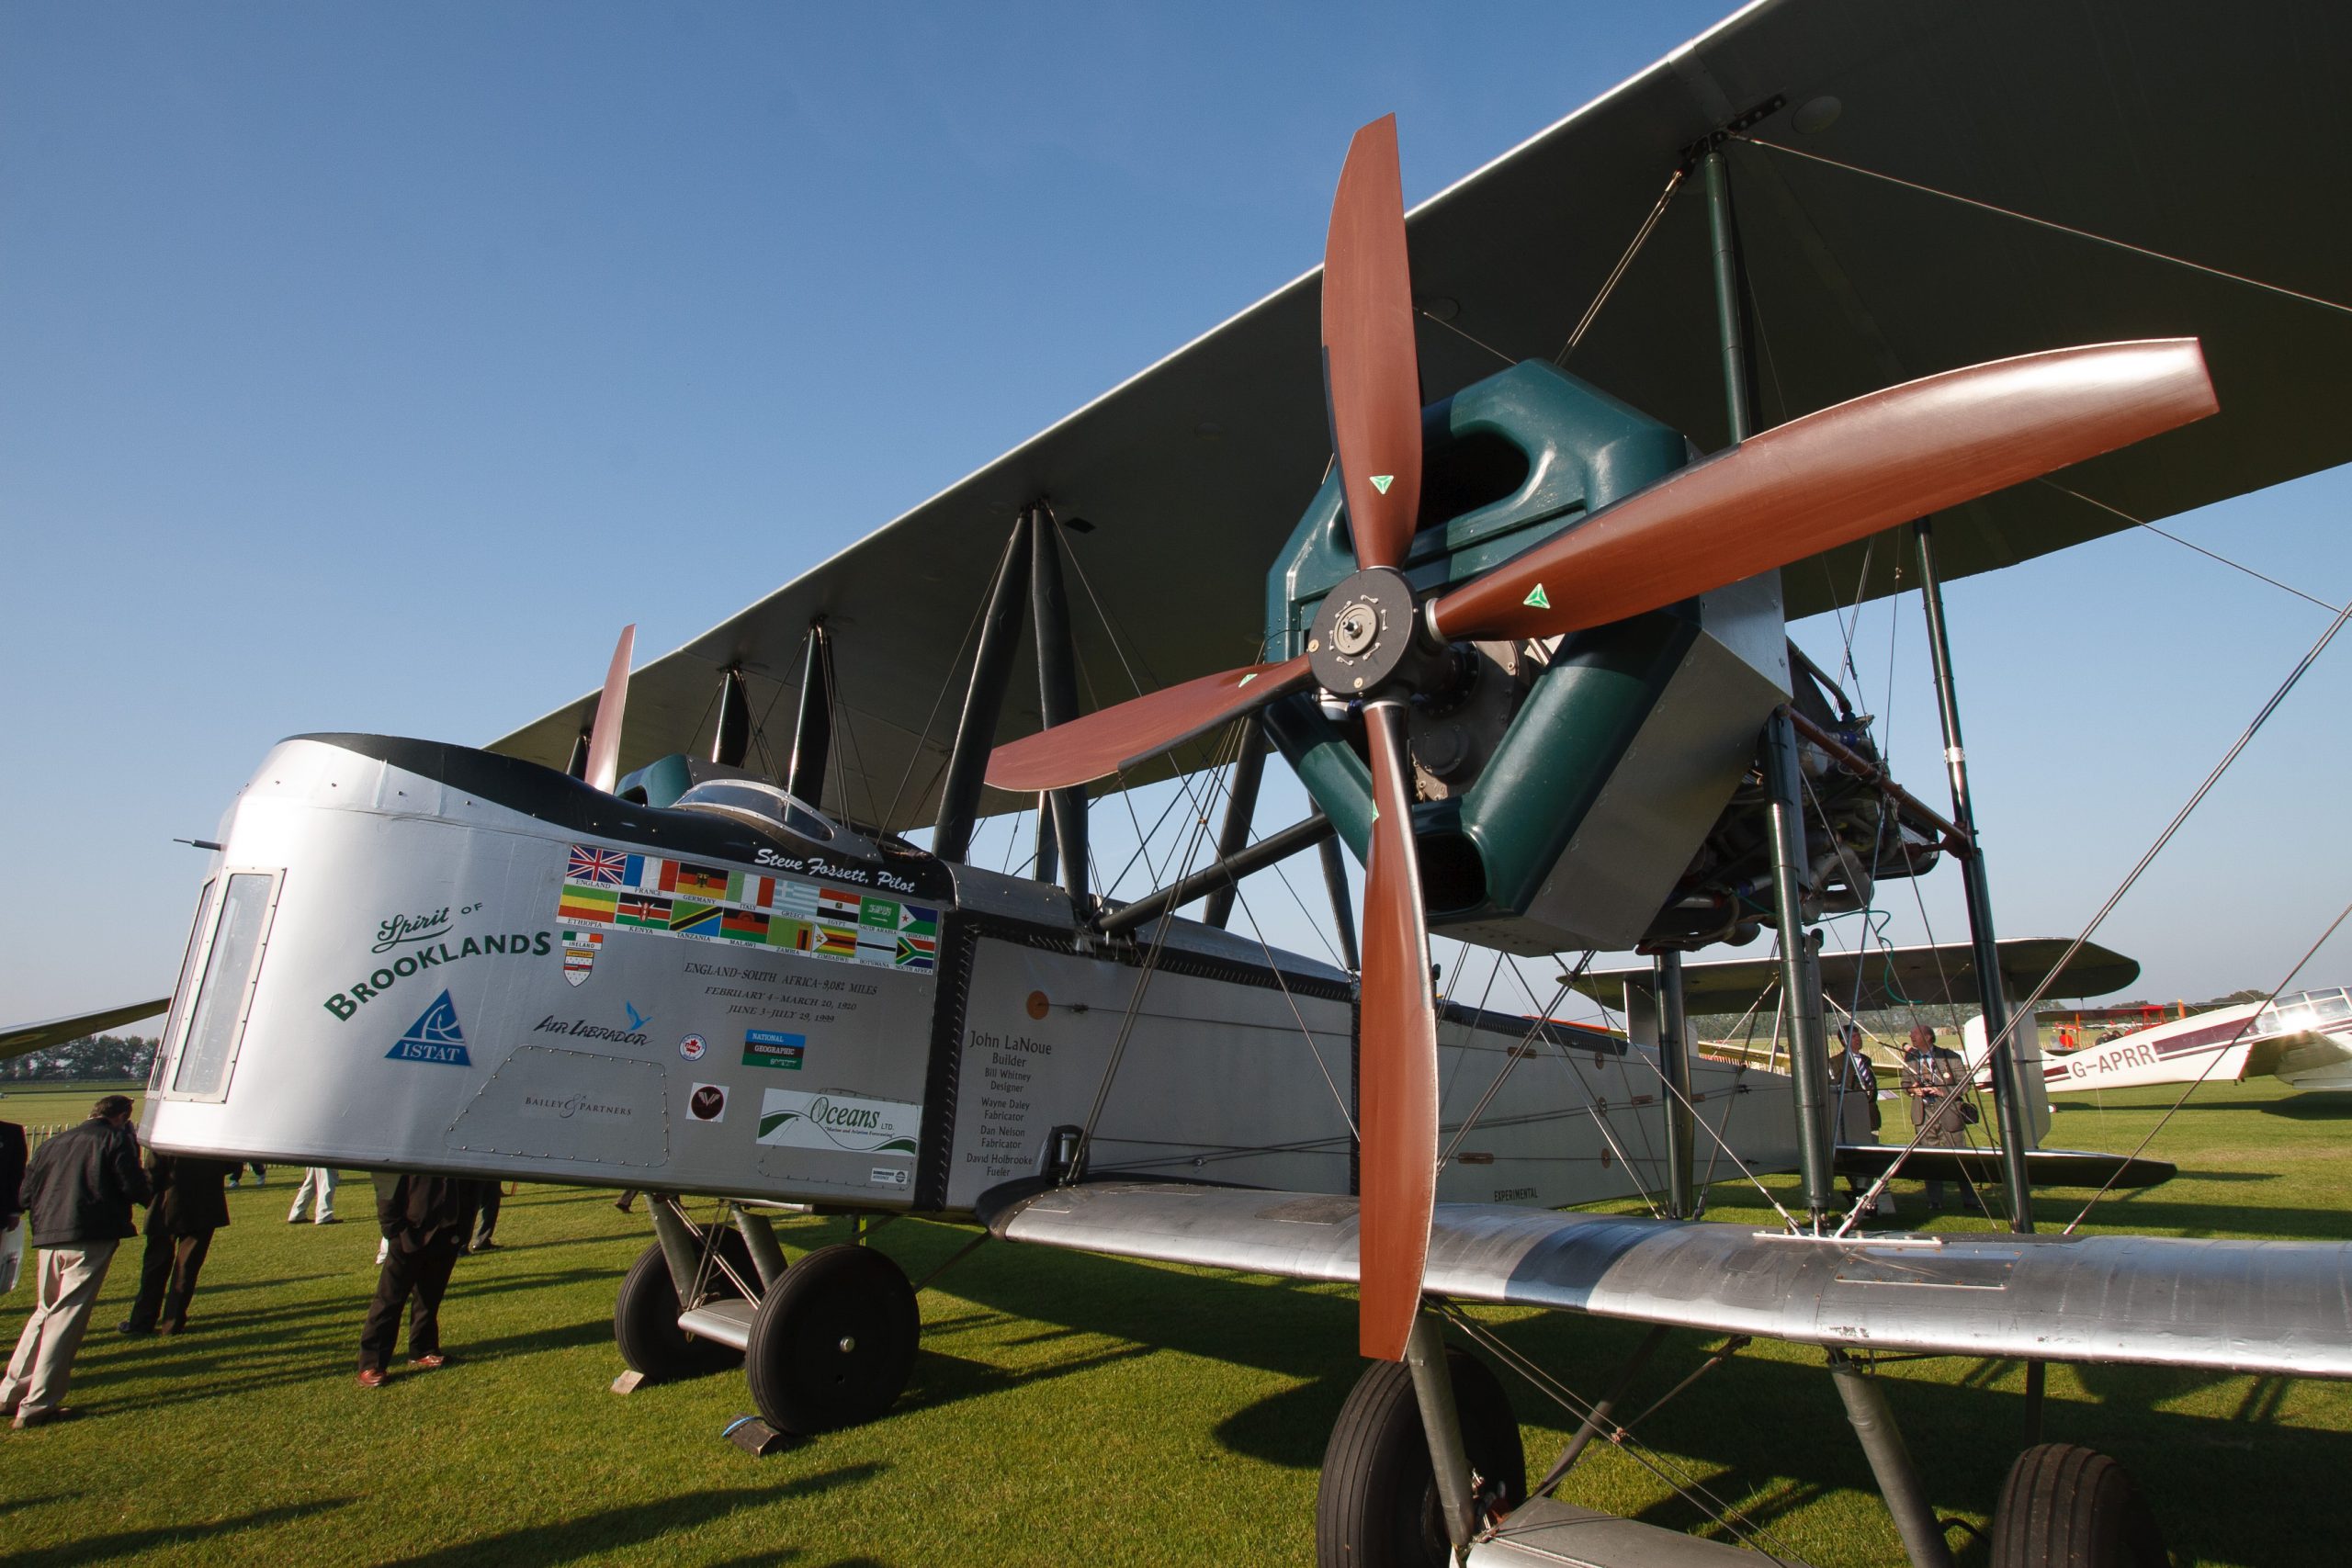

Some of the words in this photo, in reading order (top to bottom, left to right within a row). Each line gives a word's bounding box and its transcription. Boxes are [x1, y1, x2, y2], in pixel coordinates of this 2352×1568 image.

[754, 849, 803, 871] Steve
[807, 857, 869, 884] Fossett,
[877, 872, 915, 894] Pilot
[575, 878, 611, 889] ENGLAND
[635, 886, 662, 897] FRANCE
[683, 894, 716, 905] GERMANY
[740, 903, 757, 911] ITALY
[781, 910, 805, 919] GREECE
[371, 907, 454, 953] Spirit
[461, 902, 483, 915] OF
[567, 918, 603, 929] ETHIOPIA
[827, 919, 846, 928] EGYPT
[629, 926, 653, 935] KENYA
[676, 931, 711, 942] TANZANIA
[729, 939, 756, 948] MALAWI
[776, 946, 800, 956] ZAMBIA
[817, 953, 849, 963] ZIMBABWE
[859, 960, 889, 968] BOTSWANA
[323, 931, 551, 1021] BROOKLANDS
[848, 983, 877, 996] MILES
[705, 986, 765, 1000] FEBRUARY
[837, 1001, 857, 1011] 1920
[726, 1004, 756, 1015] JUNE
[814, 1013, 835, 1023] 1999
[534, 1014, 569, 1033] AIR
[570, 1020, 654, 1046] LABRADOR
[752, 1032, 784, 1043] NATIONAL
[969, 1030, 1000, 1048] John
[1005, 1035, 1052, 1055] LaNoue
[401, 1043, 460, 1062] ISTAT
[754, 1043, 795, 1055] GEOGRAPHIC
[991, 1053, 1027, 1067] Builder
[2072, 1043, 2156, 1078] G-APRR
[984, 1066, 998, 1078] Bill
[1000, 1068, 1032, 1083] Whitney
[990, 1080, 1024, 1093] Designer
[526, 1096, 563, 1109] BAILEY
[580, 1101, 632, 1116] PARTNERS
[981, 1097, 1006, 1110] Wayne
[1009, 1099, 1030, 1111] Daley
[809, 1096, 880, 1129] Oceans
[984, 1109, 1024, 1122] Fabricator
[980, 1124, 996, 1136] Dan
[999, 1126, 1025, 1137] Nelson
[981, 1137, 1022, 1149] Fabricator
[967, 1152, 989, 1164] David
[991, 1154, 1033, 1166] Holbrooke
[986, 1166, 1012, 1177] Fueler
[1494, 1187, 1539, 1202] EXPERIMENTAL
